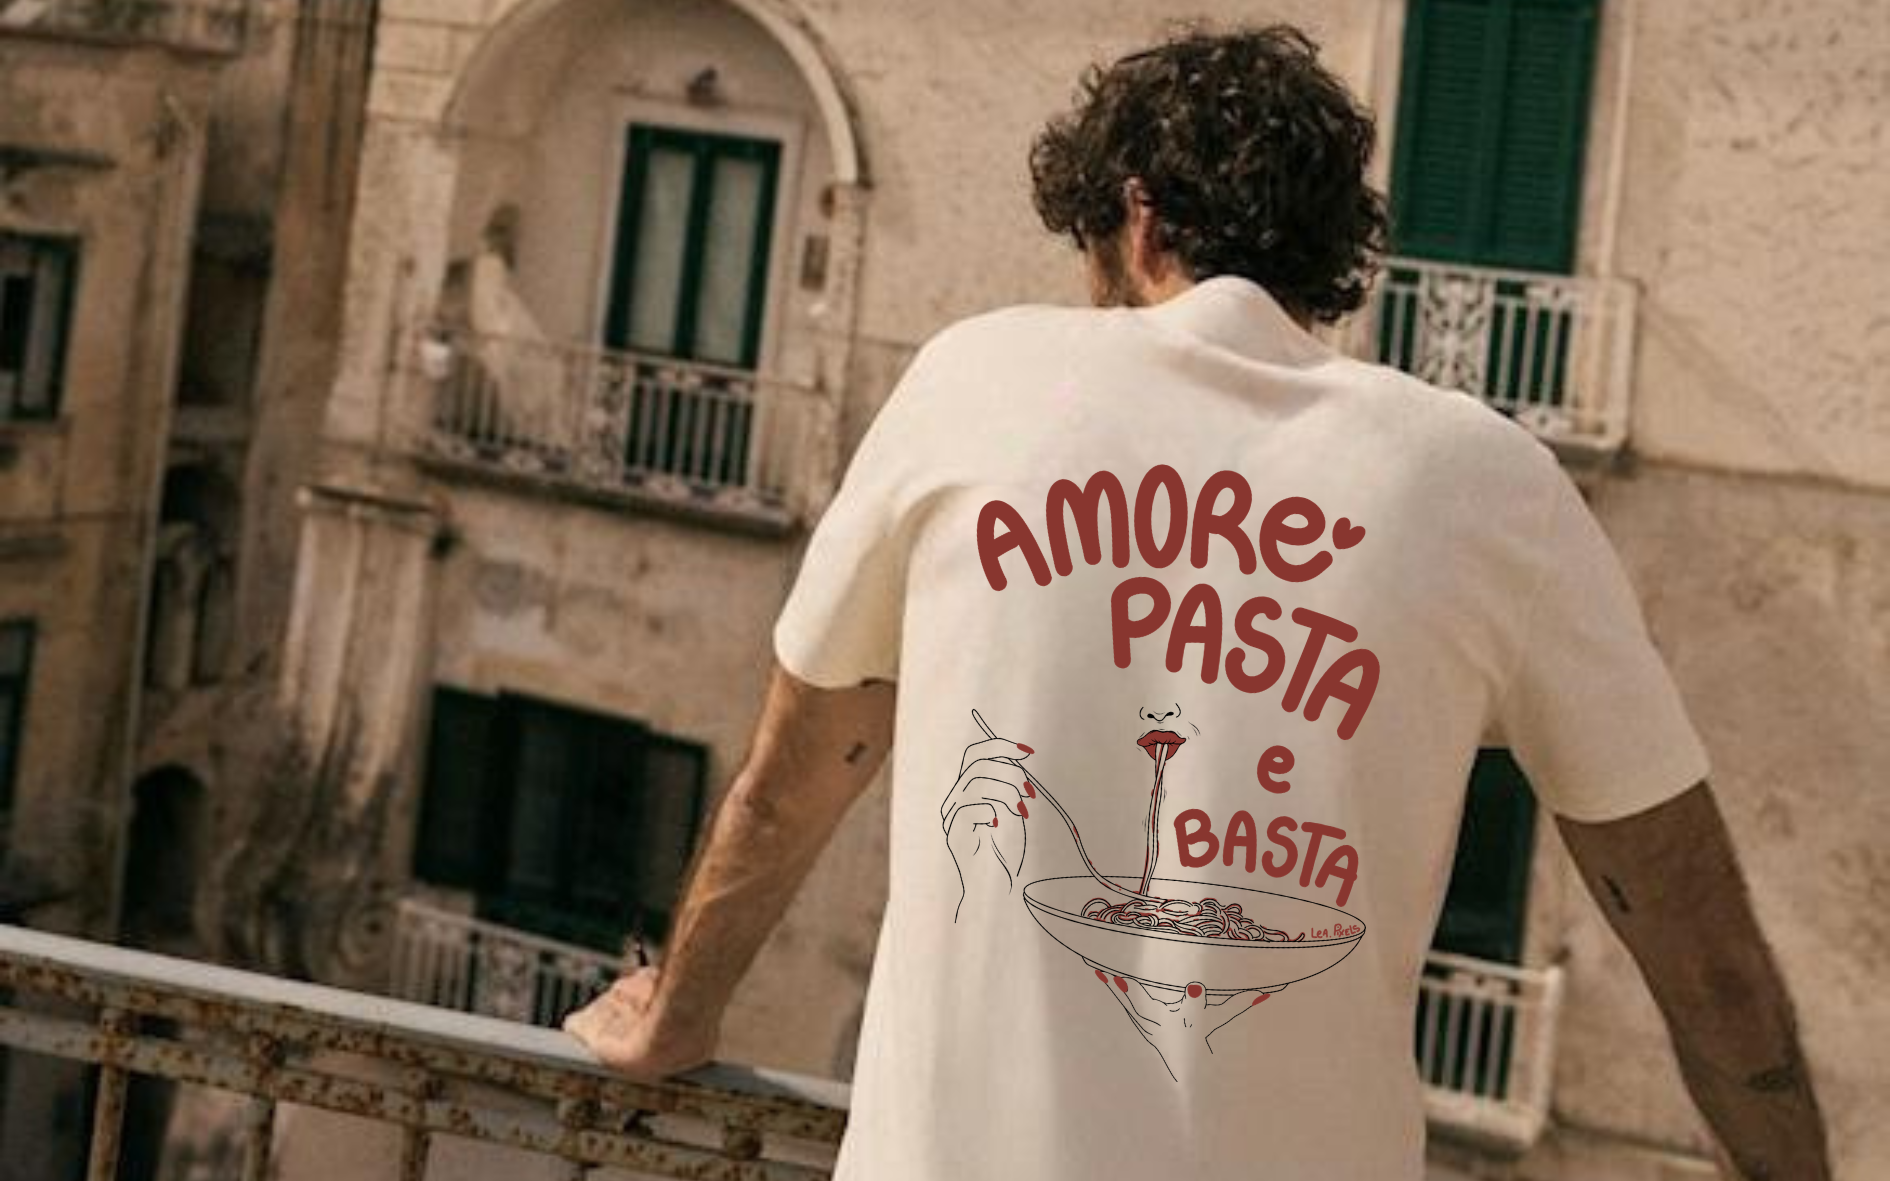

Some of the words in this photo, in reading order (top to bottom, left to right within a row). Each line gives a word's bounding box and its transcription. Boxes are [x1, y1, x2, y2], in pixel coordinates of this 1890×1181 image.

[1110, 576, 1381, 741] PASTA
[1256, 745, 1295, 794] e
[1173, 808, 1359, 908] BASTA
